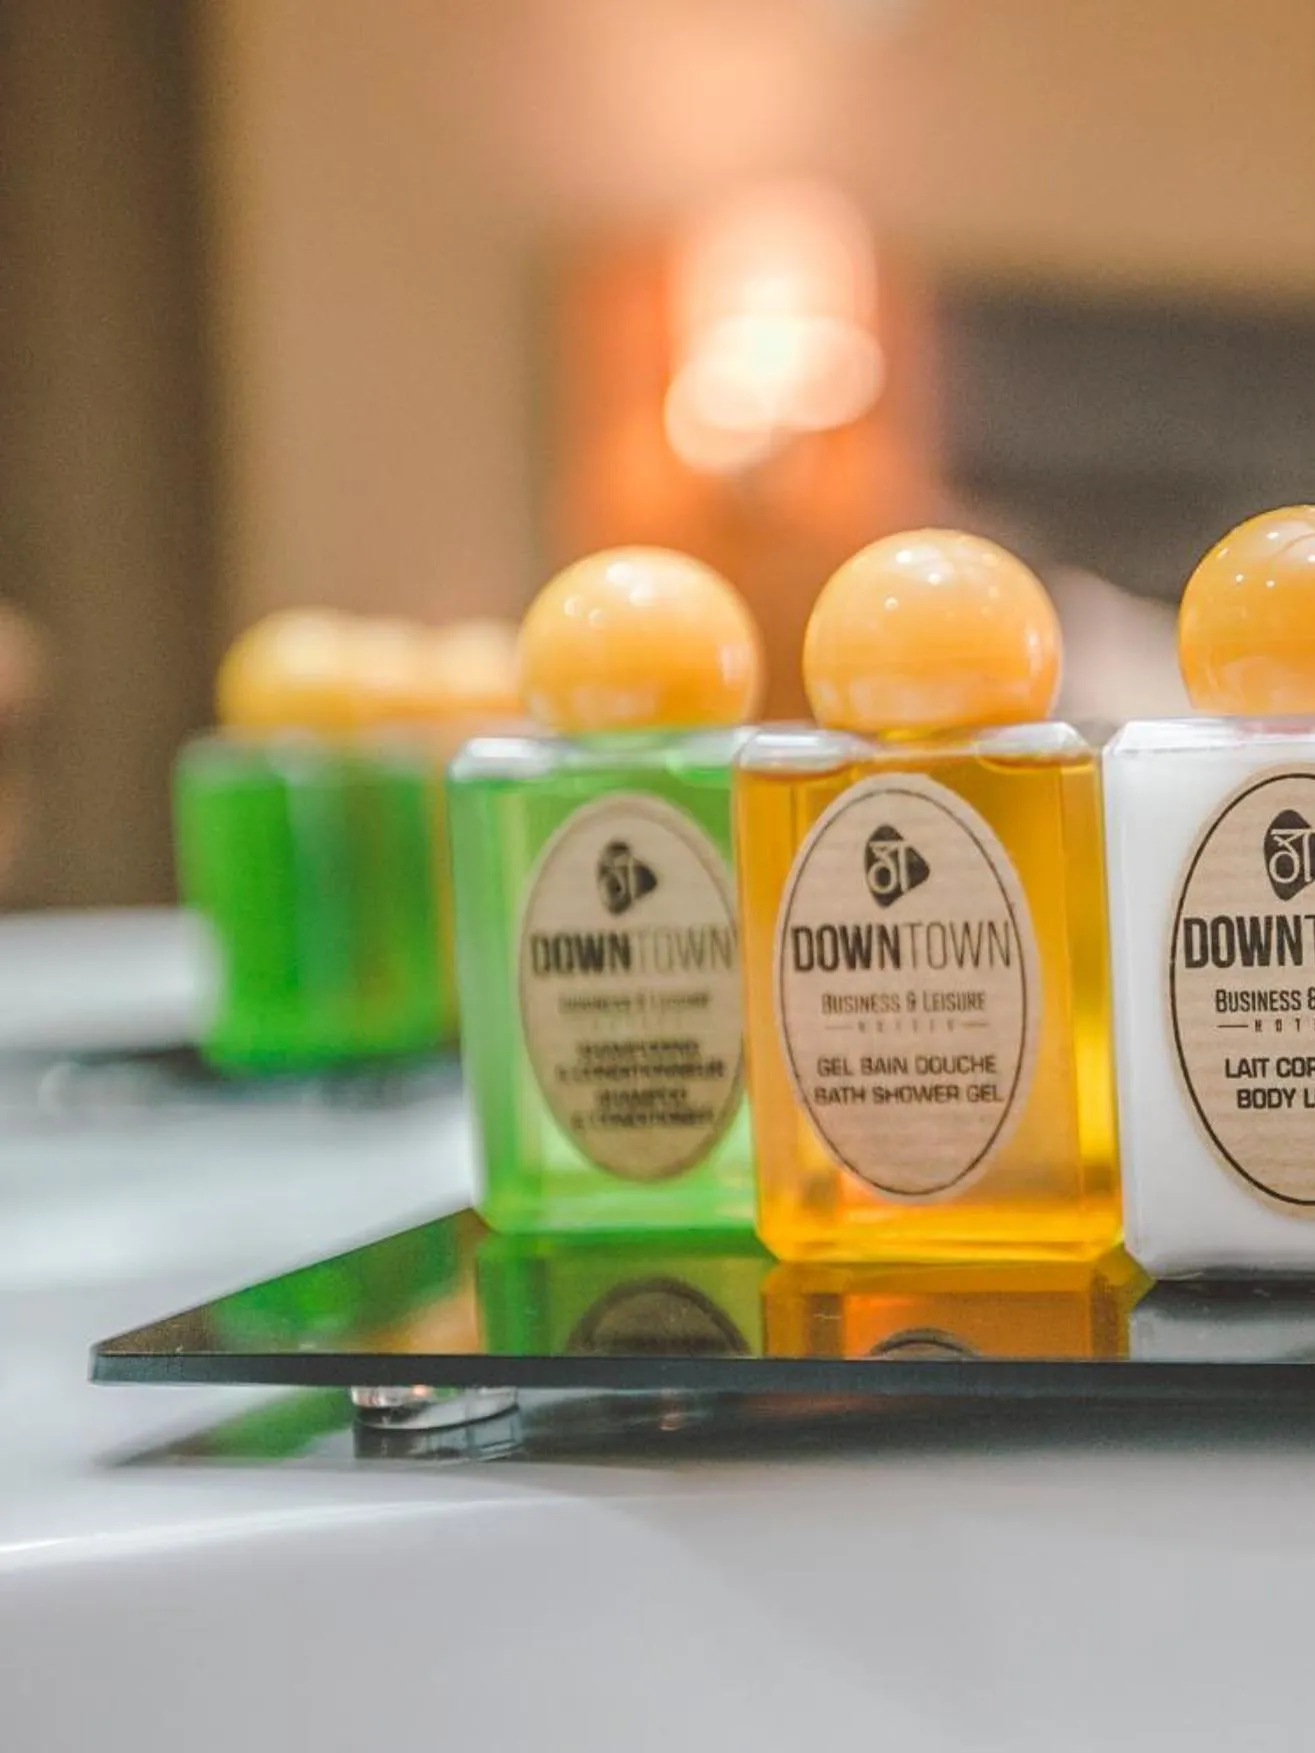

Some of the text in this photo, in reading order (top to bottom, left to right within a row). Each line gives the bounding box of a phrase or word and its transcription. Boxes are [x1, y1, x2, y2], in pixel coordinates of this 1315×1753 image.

[531, 922, 736, 976] DOWNTOWN
[791, 920, 1012, 971] DOWNTOWN
[821, 992, 900, 1015] BUSINESS
[922, 990, 986, 1012] LEISURE
[1215, 988, 1301, 1013] BUSINESS
[817, 1055, 996, 1077] GEL BAIN DOUCHE
[1225, 1057, 1270, 1078] LAIT
[814, 1083, 1004, 1105] BATH SHOWER GEL
[1237, 1087, 1296, 1109] BODY
